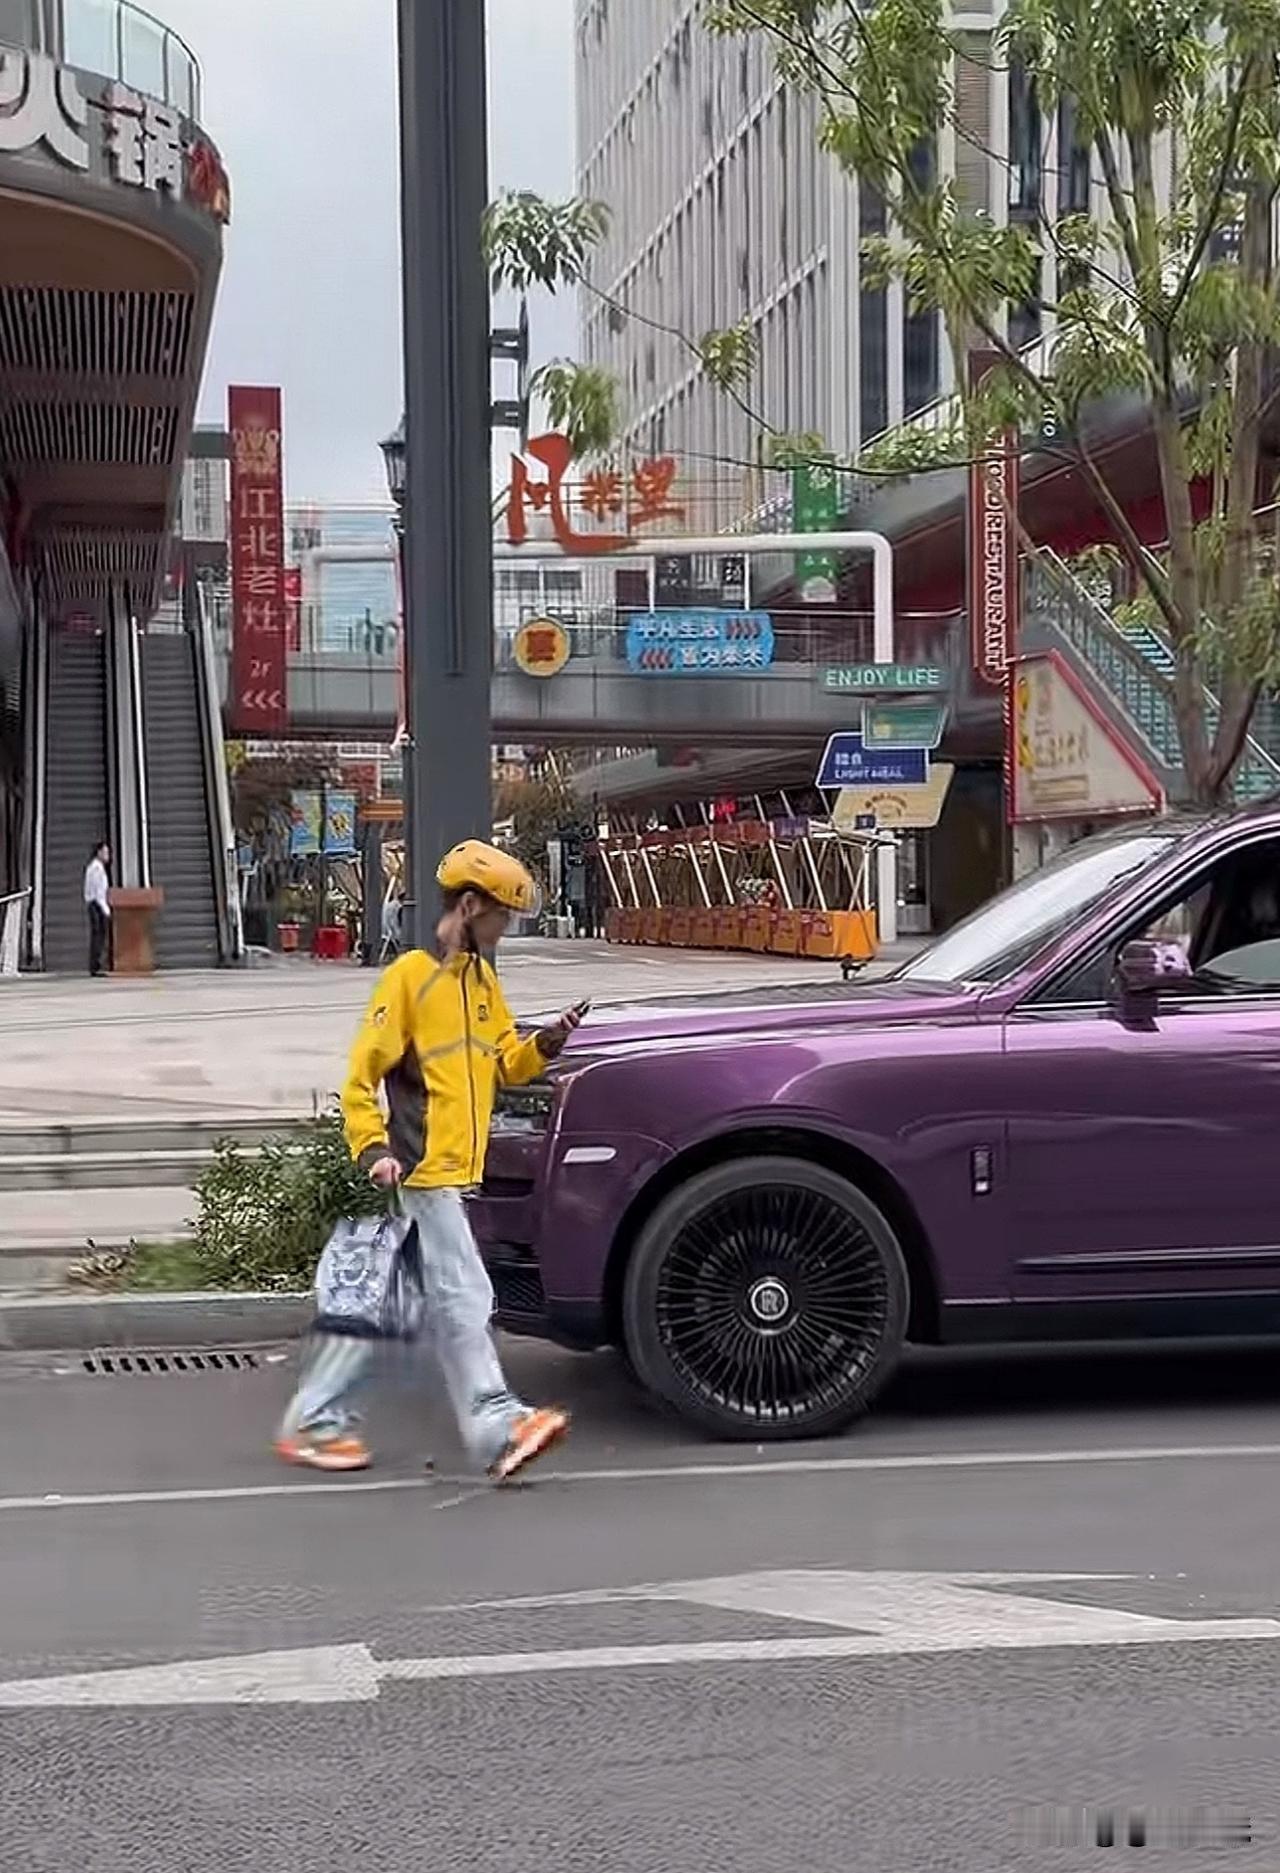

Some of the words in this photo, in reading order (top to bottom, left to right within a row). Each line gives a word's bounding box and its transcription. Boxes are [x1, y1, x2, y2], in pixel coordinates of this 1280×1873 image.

[240, 487, 280, 633] 江北老灶
[984, 511, 1007, 668] RESTAURANT
[826, 669, 887, 687] ENJOY
[896, 668, 942, 686] LIFE
